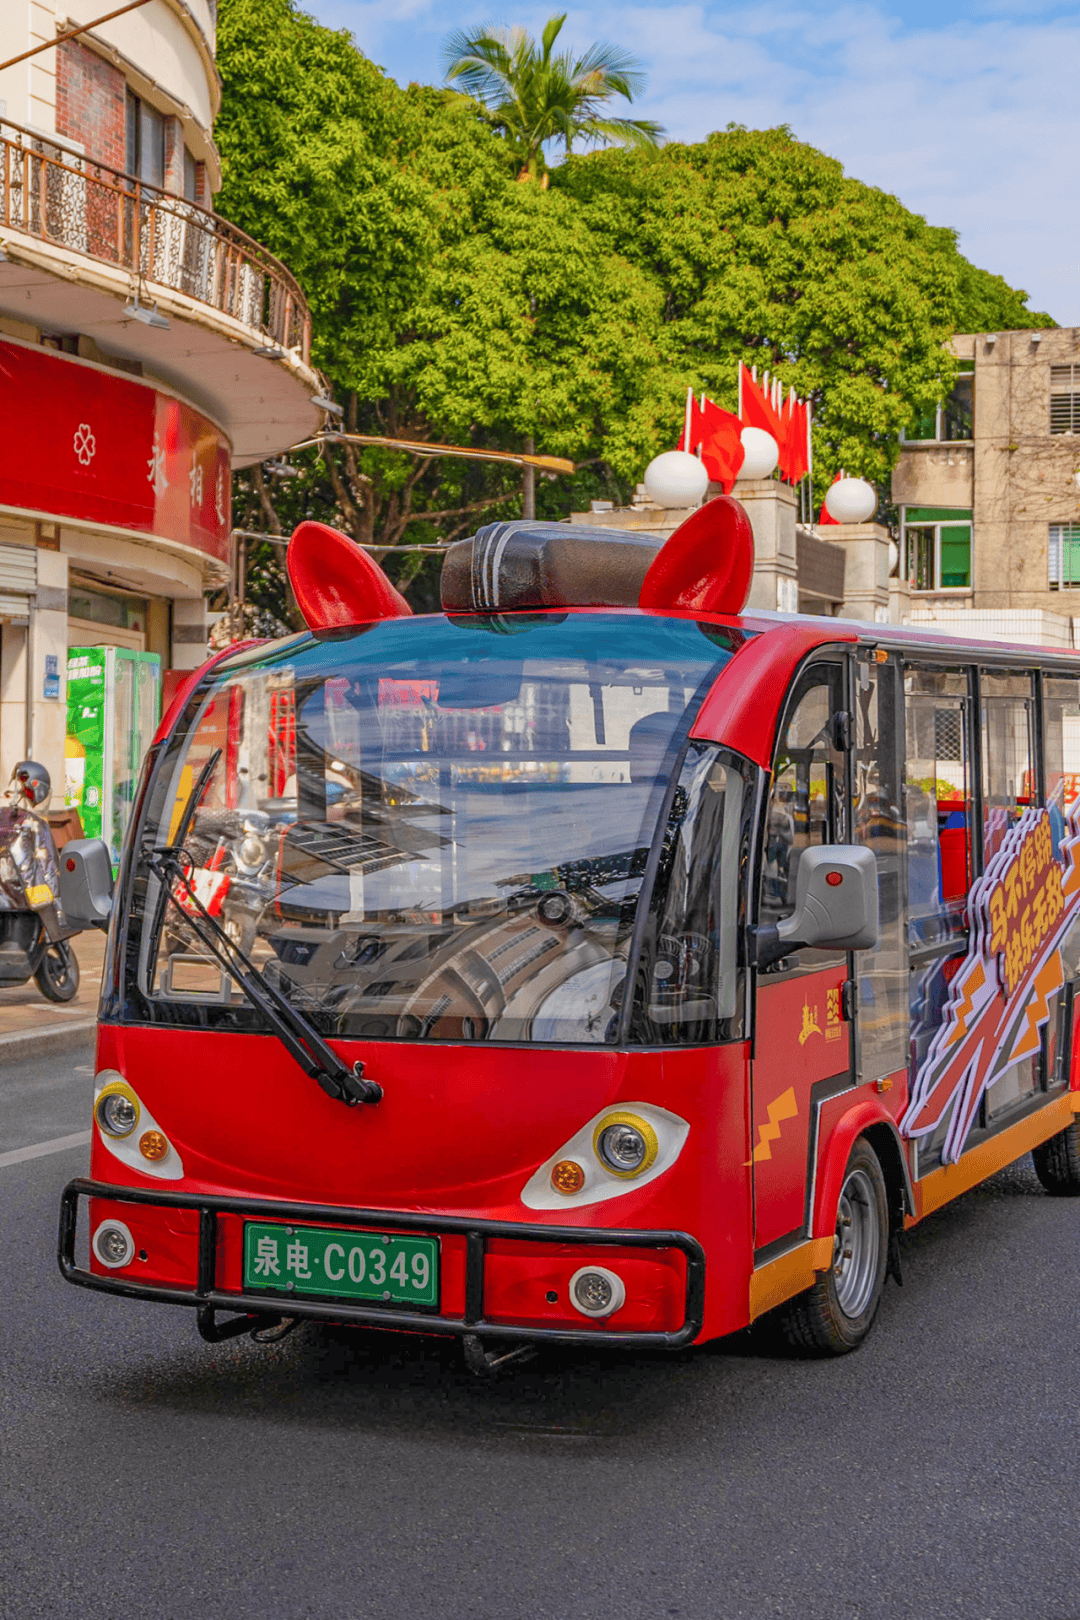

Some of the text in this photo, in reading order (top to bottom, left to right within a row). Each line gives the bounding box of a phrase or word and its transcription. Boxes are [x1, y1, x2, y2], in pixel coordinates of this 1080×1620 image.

[990, 810, 1052, 953] 马不停蹄
[1005, 865, 1065, 993] 快乐无敌
[254, 1236, 430, 1289] 泉电·C0349
